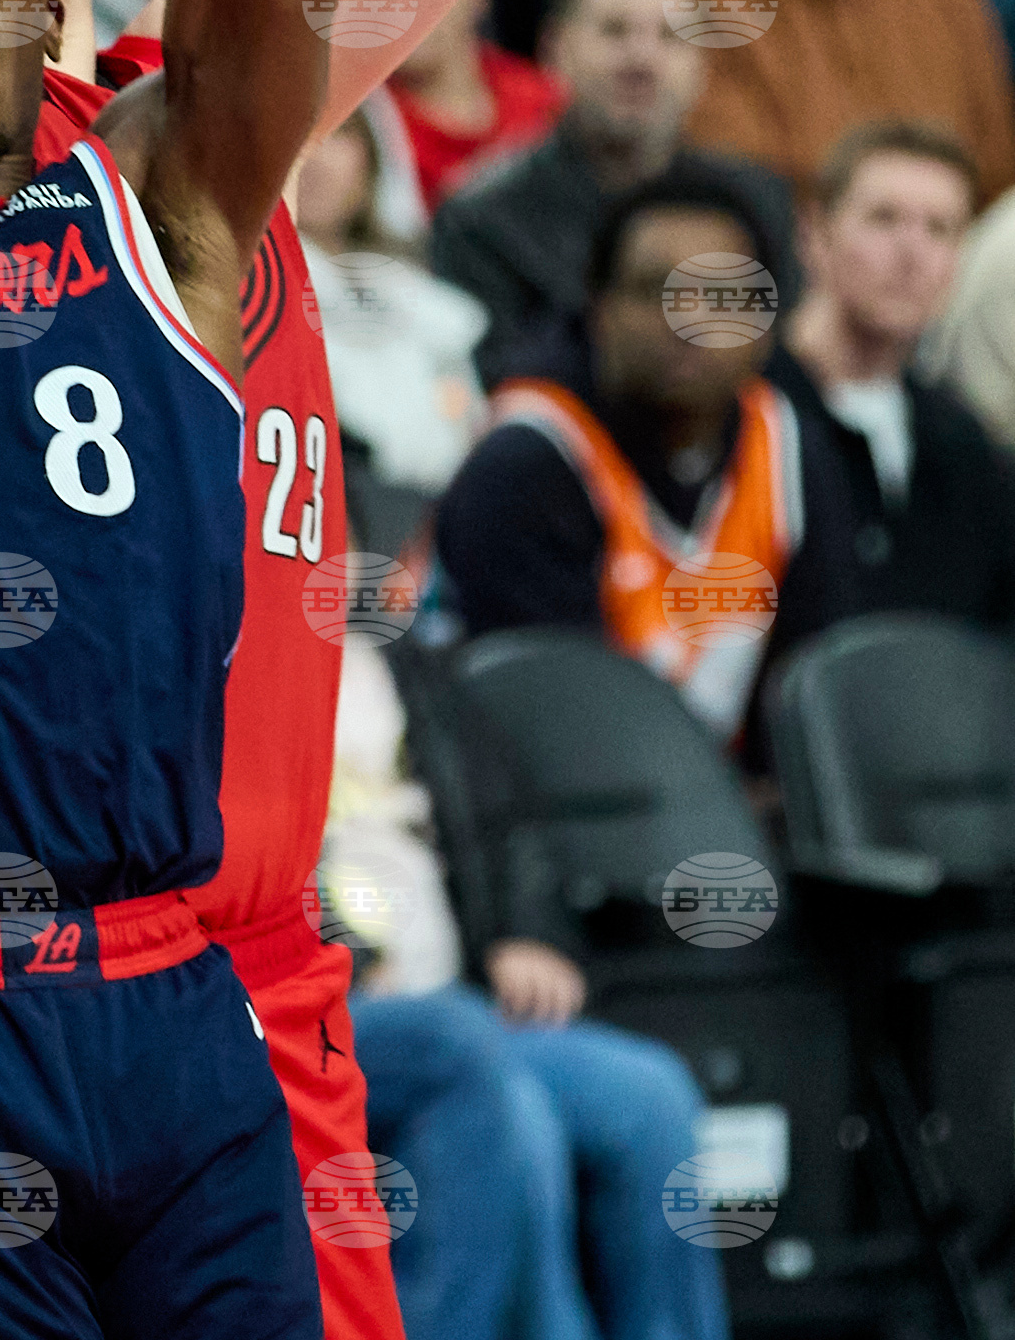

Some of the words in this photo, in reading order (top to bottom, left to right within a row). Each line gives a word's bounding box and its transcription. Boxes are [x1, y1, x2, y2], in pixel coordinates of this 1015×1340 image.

[34, 365, 136, 517] 8
[257, 407, 327, 564] 23
[24, 921, 82, 974] LA
